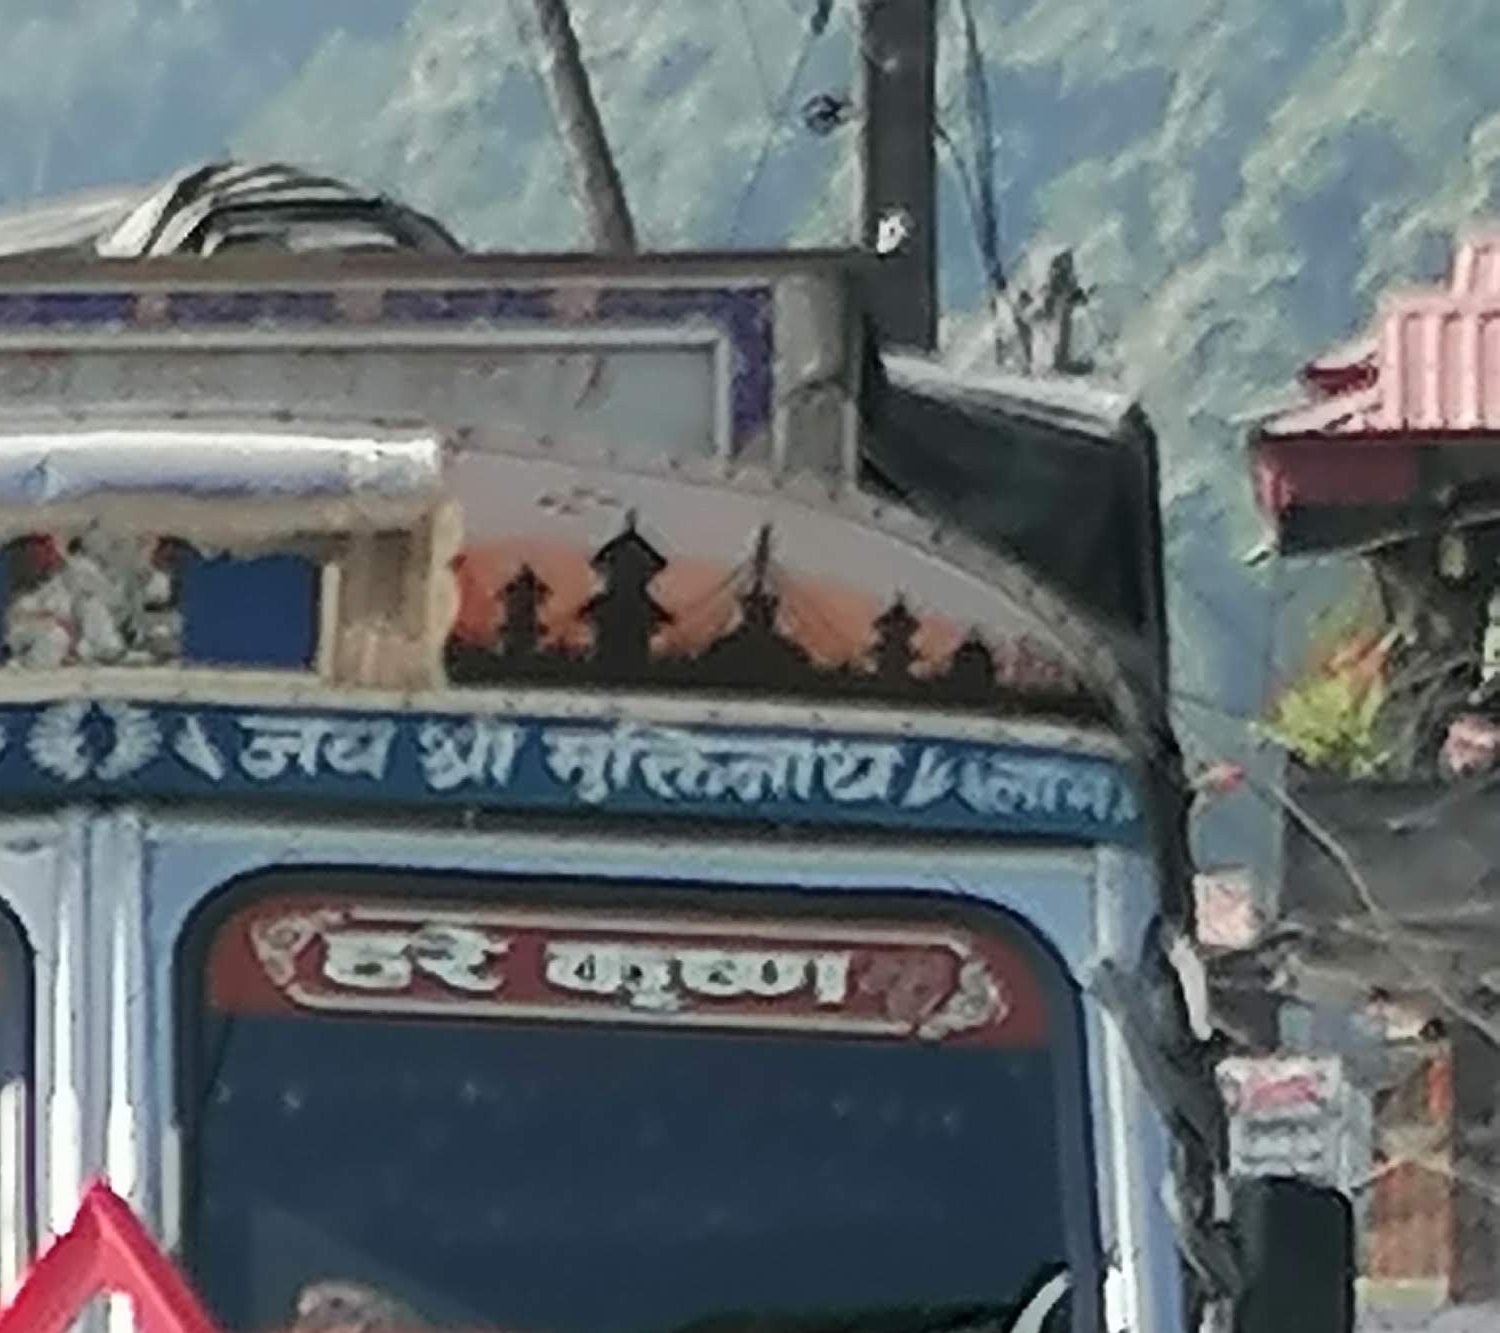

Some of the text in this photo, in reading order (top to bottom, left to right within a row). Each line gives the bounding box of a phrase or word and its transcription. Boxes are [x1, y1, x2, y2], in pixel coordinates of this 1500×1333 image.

[238, 716, 396, 780] जय
[418, 716, 527, 790] श्री
[322, 924, 852, 1014] हरे कृष्ण
